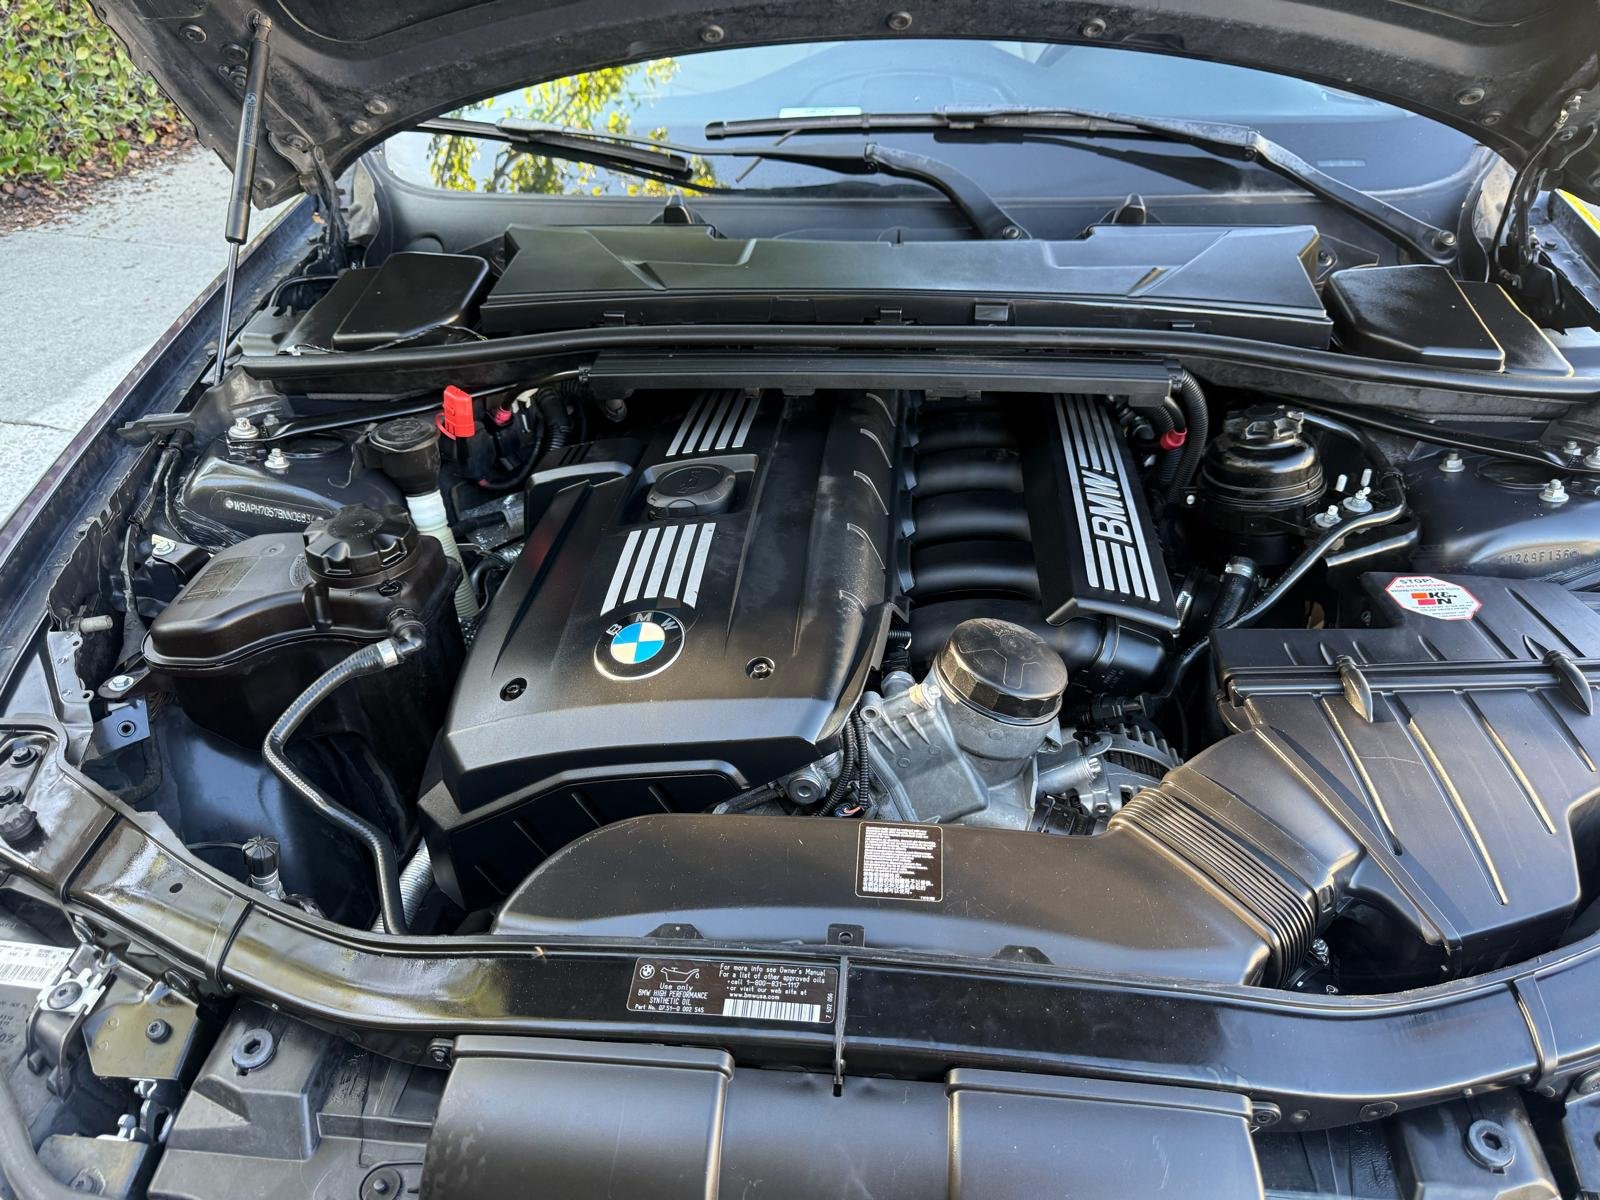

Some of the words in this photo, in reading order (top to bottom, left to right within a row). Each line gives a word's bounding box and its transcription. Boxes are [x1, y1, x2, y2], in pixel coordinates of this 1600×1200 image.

[1080, 469, 1133, 543] BMW
[606, 612, 679, 636] BMW
[805, 968, 826, 976] Manual
[677, 984, 693, 992] only
[669, 990, 708, 999] PERFORMANCE
[649, 996, 680, 1005] SYNTHETIC
